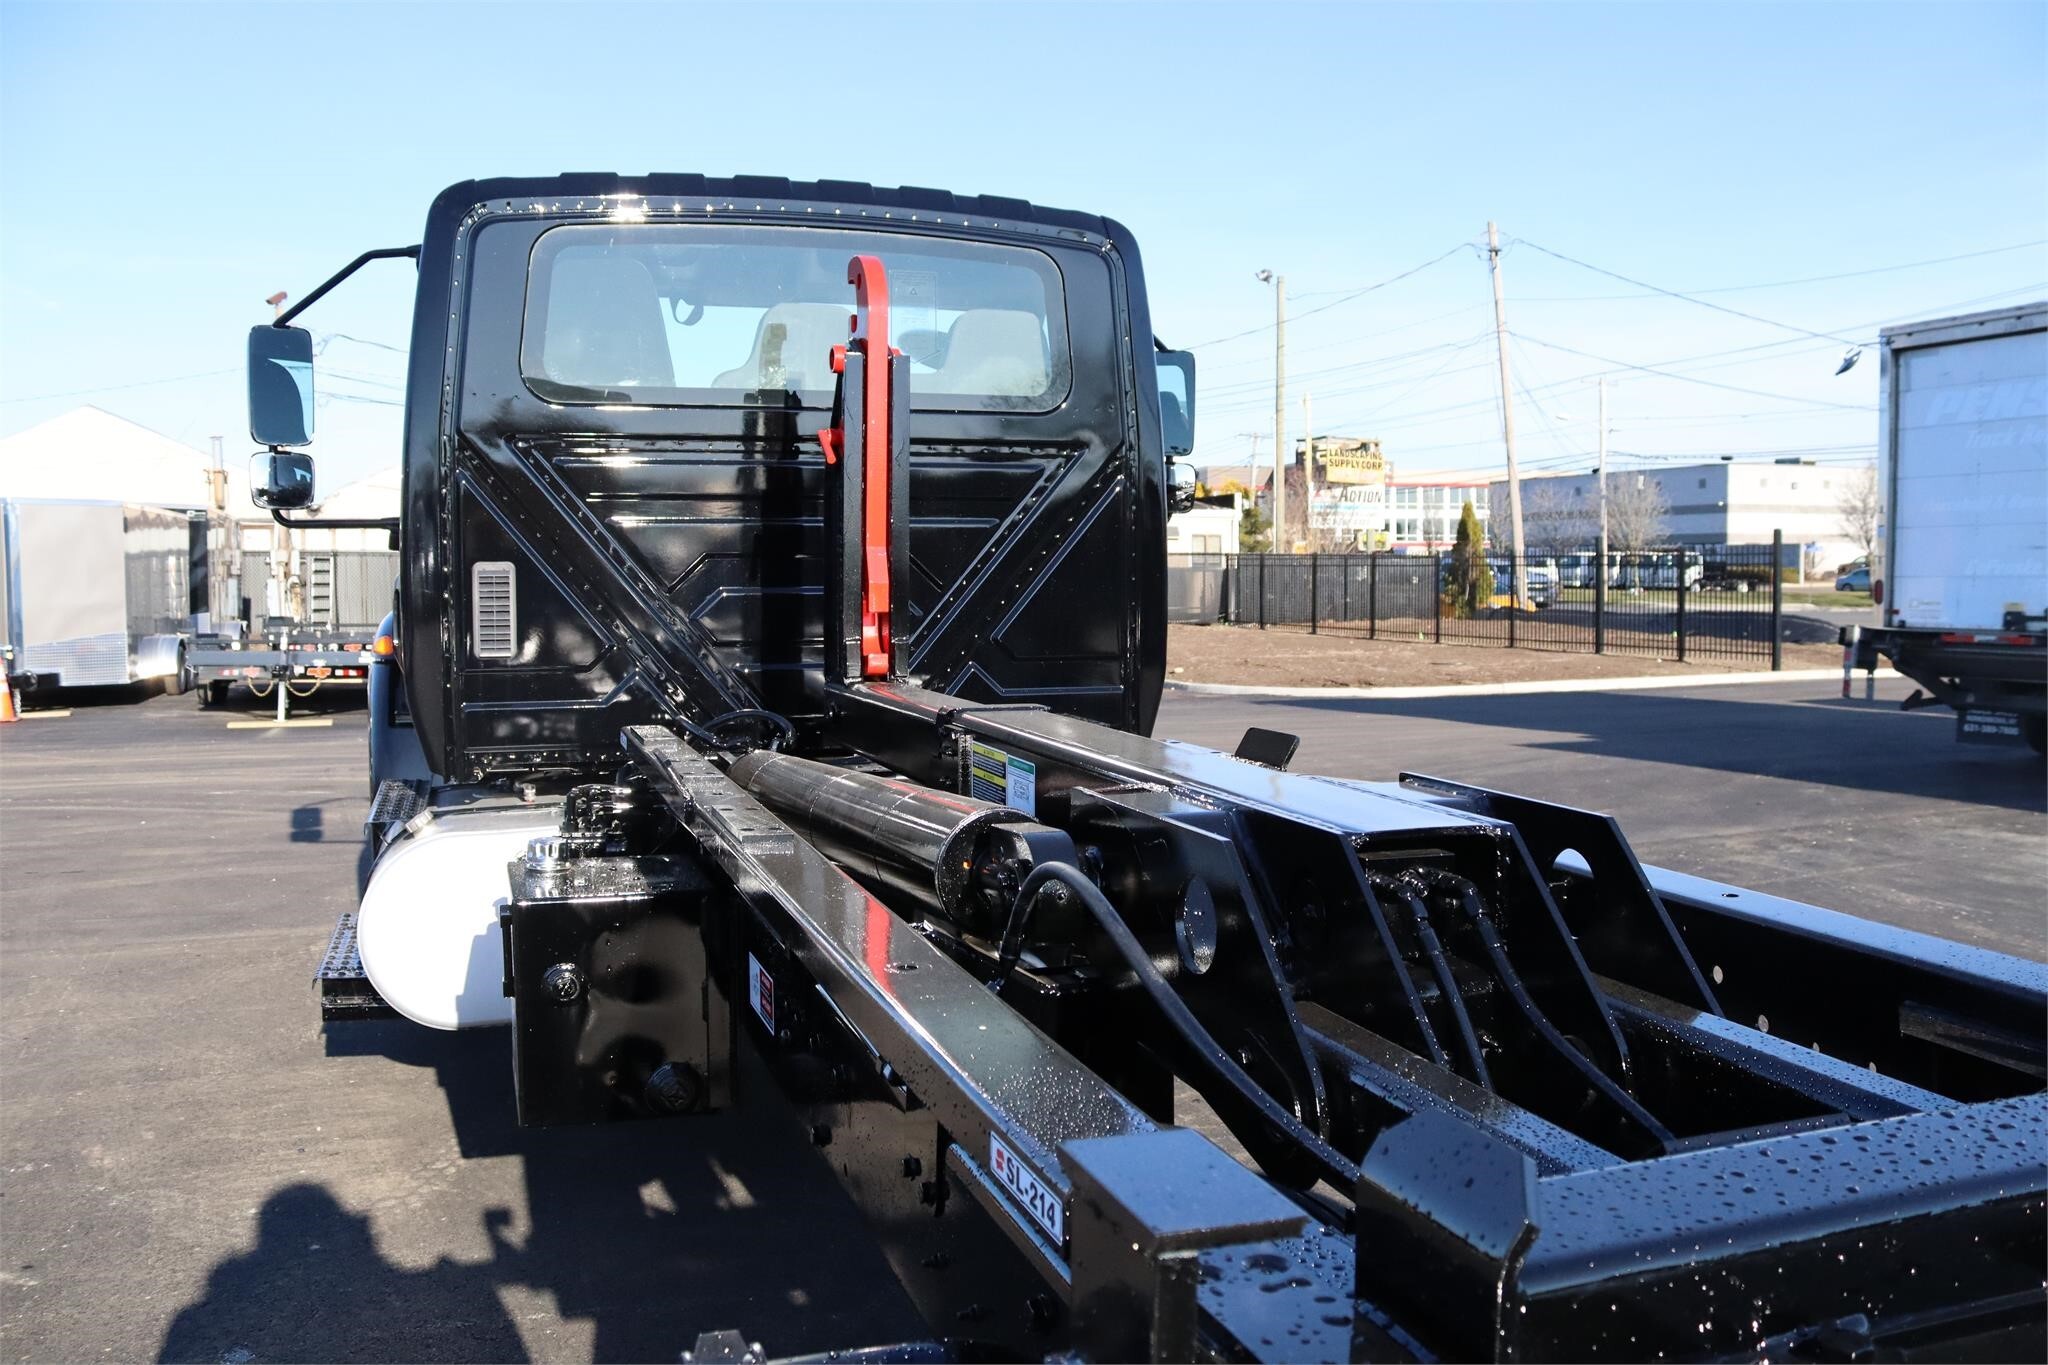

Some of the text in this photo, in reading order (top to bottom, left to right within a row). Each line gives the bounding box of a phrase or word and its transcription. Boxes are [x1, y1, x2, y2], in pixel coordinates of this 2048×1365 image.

[1329, 448, 1383, 461] LANDSCAPING
[1329, 458, 1360, 469] SUPPLY
[1006, 1156, 1056, 1229] SL-214
